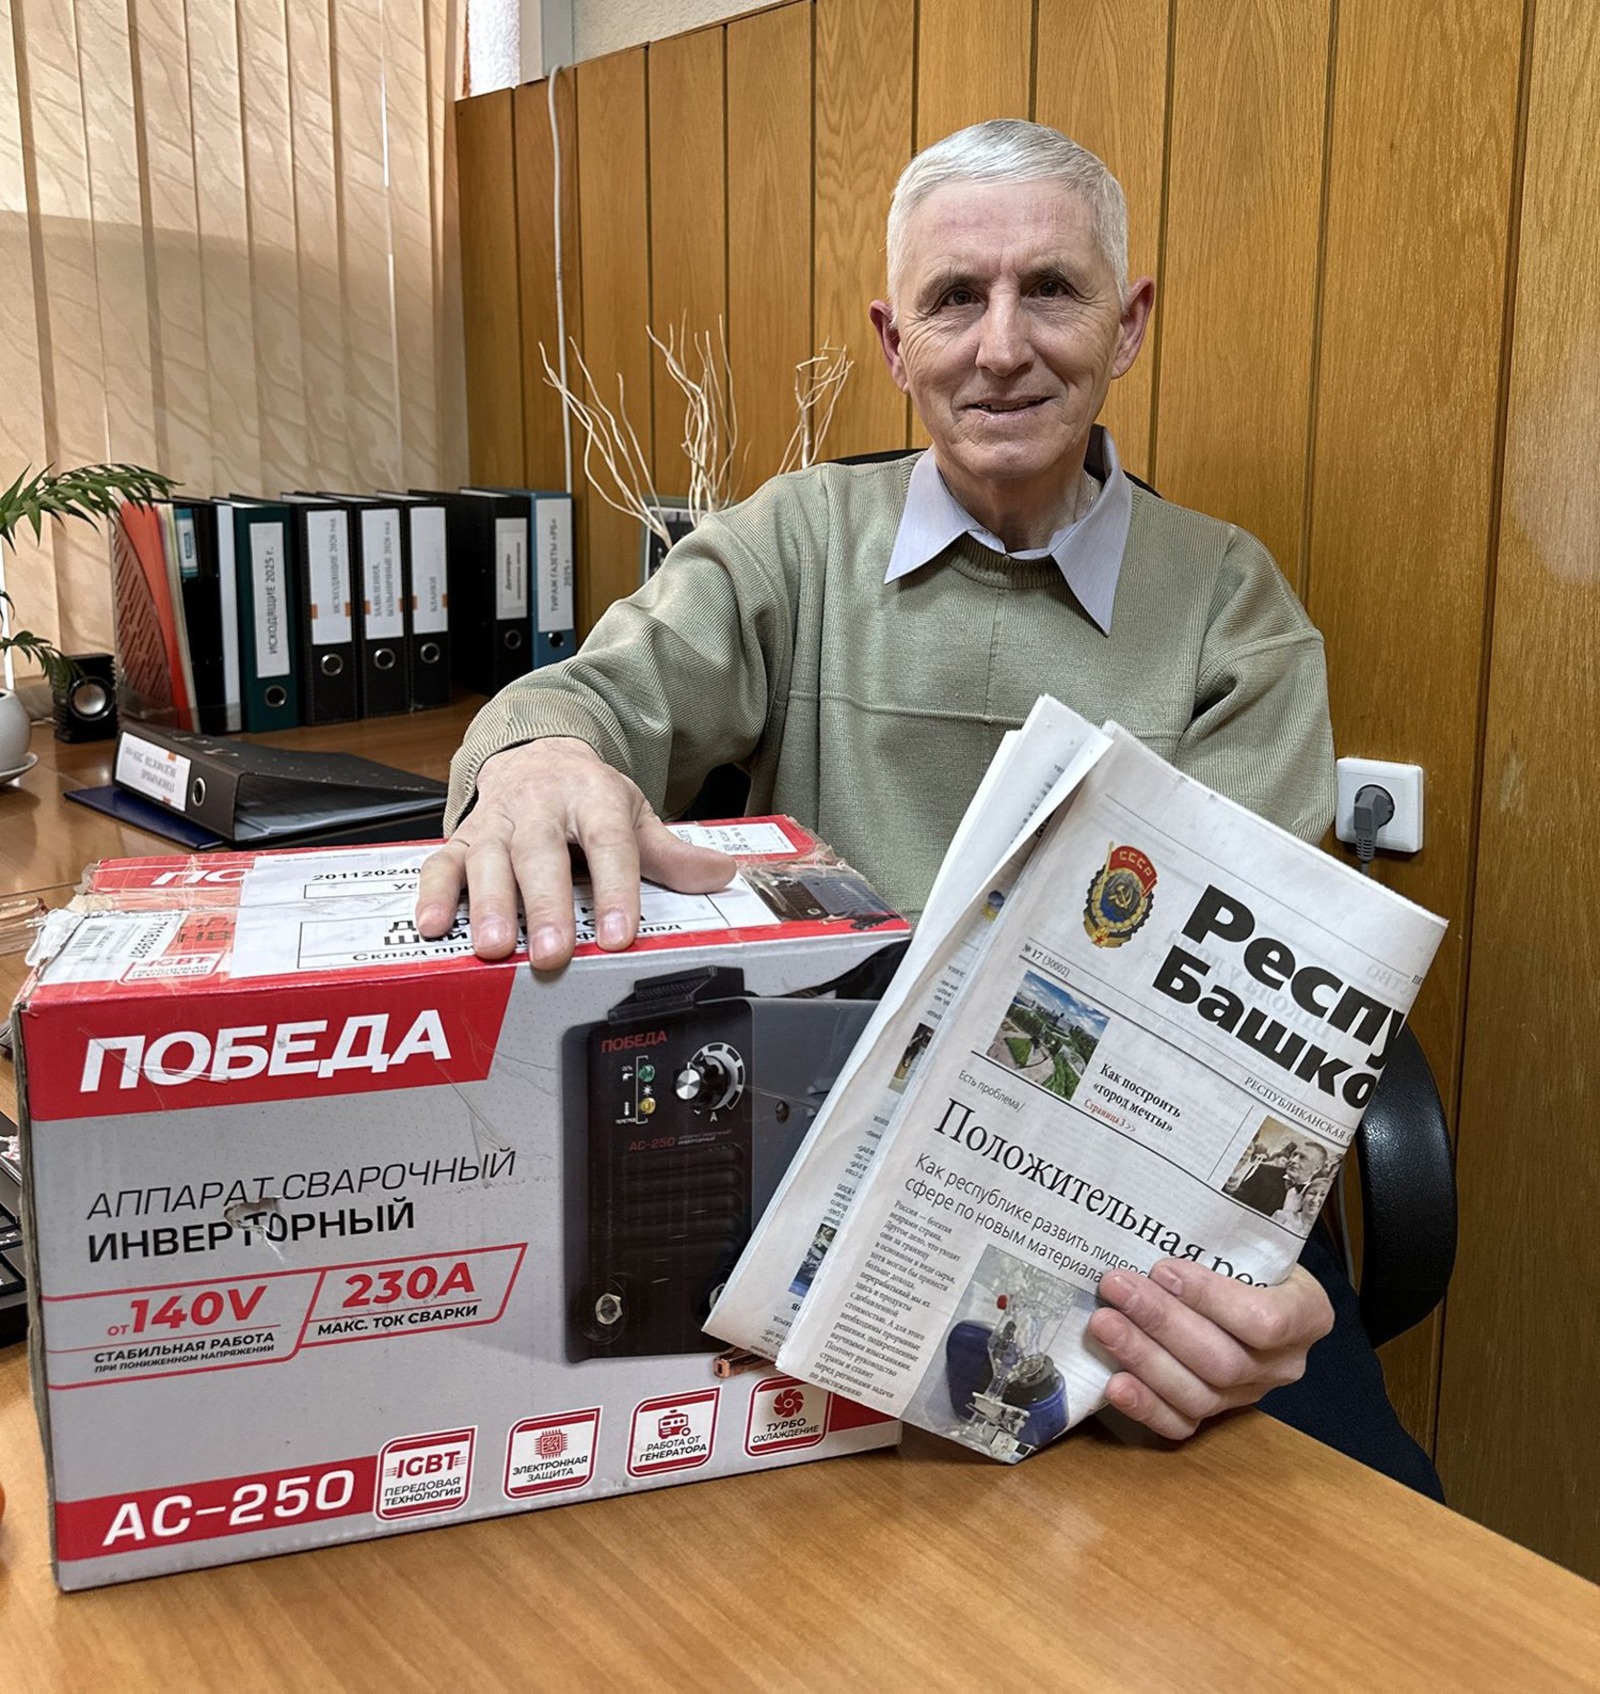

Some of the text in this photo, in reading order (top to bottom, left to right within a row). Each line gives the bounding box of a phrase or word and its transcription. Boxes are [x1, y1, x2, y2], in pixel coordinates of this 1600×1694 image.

[264, 556, 276, 582] 2025
[550, 543, 558, 578] ГАЗЕТЫ
[550, 580, 559, 612] ТИРАЖ
[265, 585, 278, 654] ИСХОДЯЩИЕ
[1120, 850, 1153, 876] СССР
[353, 950, 428, 961] Склад
[1032, 950, 1043, 960] 17
[1042, 955, 1070, 978] (30002)
[80, 1008, 453, 1093] ПОБЕДА
[601, 1030, 667, 1053] ПОБЕДА
[958, 1070, 977, 1086] Есть
[1100, 1064, 1181, 1118] Как построить
[1084, 1099, 1120, 1124] Страница
[1120, 1119, 1126, 1127] 3
[1093, 1082, 1173, 1132] «город мечты»
[1244, 1077, 1346, 1140] РЕСПУБЛИКАНСКАЯ
[629, 1137, 675, 1151] АС-250
[86, 1148, 517, 1220] АППАРАТ СВАРОЧНЫЙ
[934, 1098, 1206, 1262] Положительная
[905, 1178, 954, 1210] сфере
[954, 1202, 974, 1219] по
[975, 1212, 1027, 1246] новым
[915, 1153, 946, 1180] Как
[944, 1172, 1033, 1223] республике
[1031, 1216, 1089, 1252] развить
[87, 1197, 416, 1262] ИНВЕРТОРНЫЙ
[342, 1262, 475, 1308] 230A
[107, 1285, 268, 1336] от 140V
[318, 1305, 477, 1336] МАКС. ТОК СВАРКИ
[94, 1332, 274, 1363] СТАБИЛЬНАЯ РАБОТА
[94, 1344, 274, 1373] ПРИ ПОНИЖЕННОМ НАПРЯЖЕНИИ
[752, 1425, 820, 1444] ОХЛАЖДЕНИЕ
[766, 1418, 806, 1433] ТУРБО
[639, 1443, 707, 1462] ГЕНЕРАТОРА
[647, 1435, 700, 1452] РАБОТА ОТ
[397, 1451, 461, 1478] IGBT
[512, 1455, 588, 1476] ЭЛЕКТРОННАЯ
[526, 1467, 574, 1483] ЗАЩИТА
[385, 1476, 461, 1497] ПЕРЕДОВАЯ
[385, 1486, 461, 1506] ТЕХНОЛОГИЯ
[102, 1469, 354, 1547] АС-250
